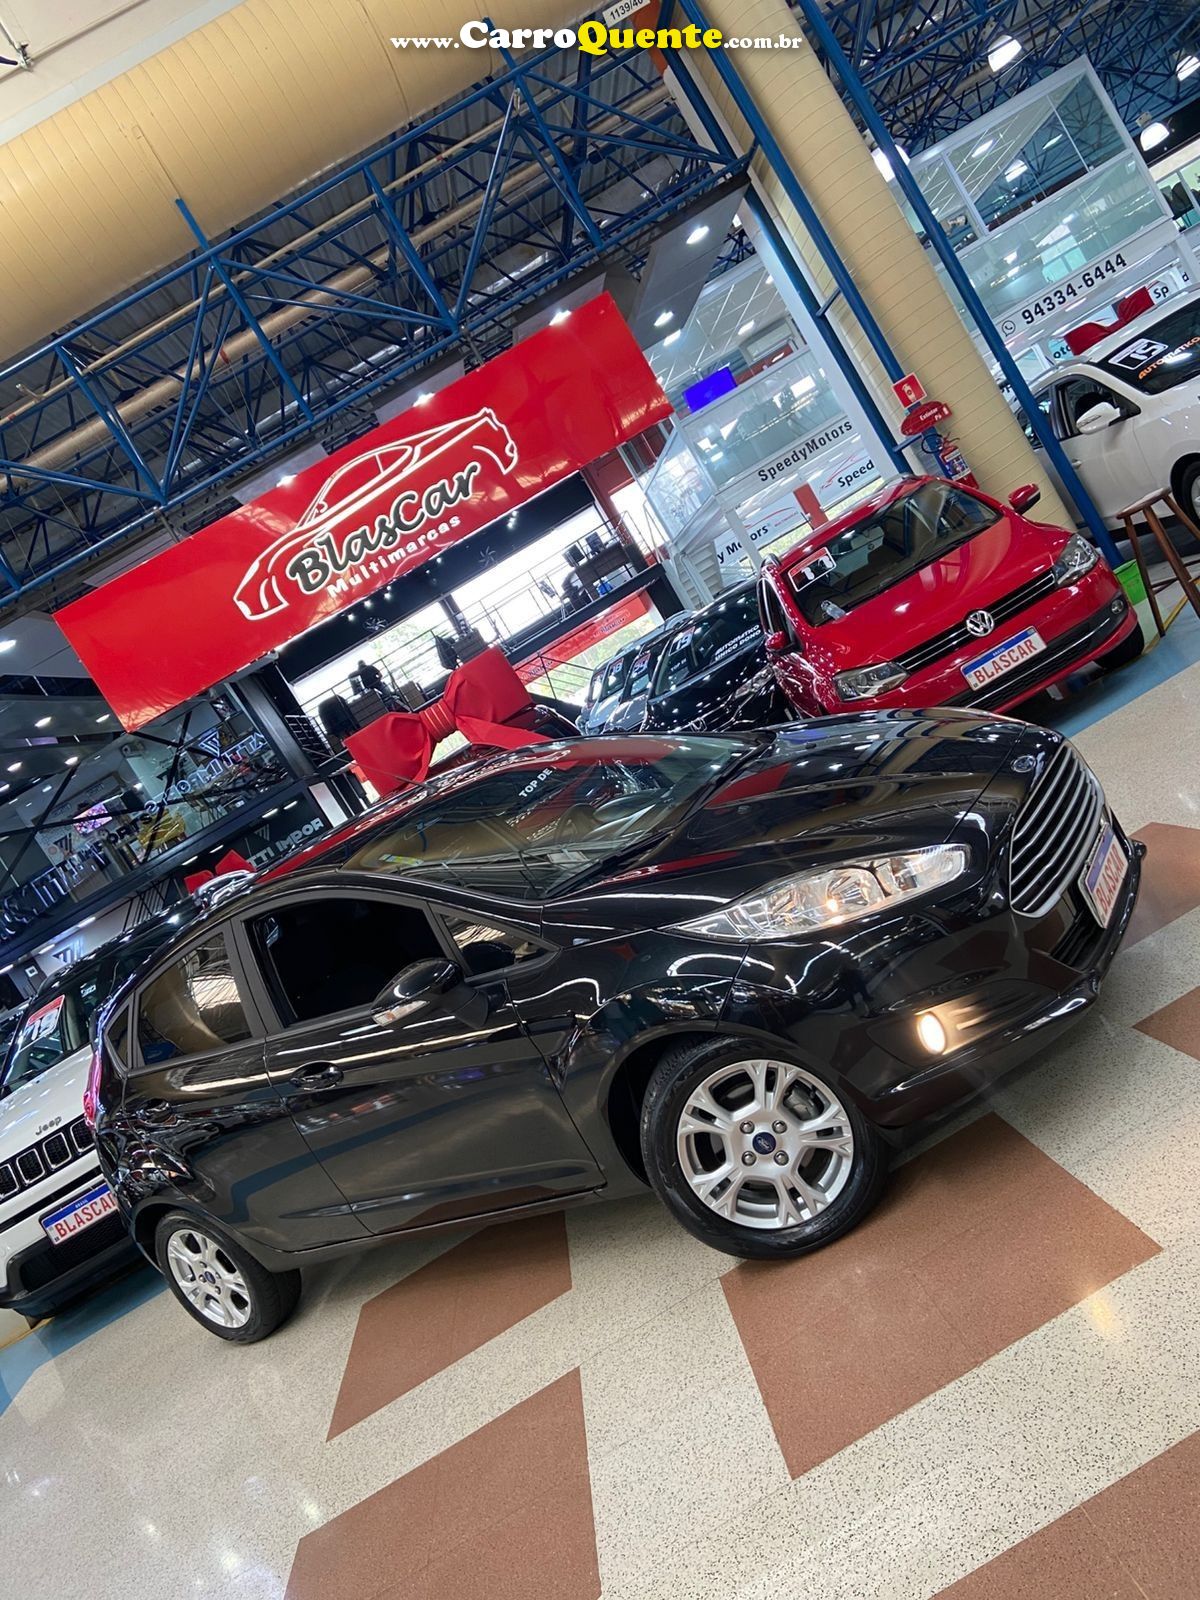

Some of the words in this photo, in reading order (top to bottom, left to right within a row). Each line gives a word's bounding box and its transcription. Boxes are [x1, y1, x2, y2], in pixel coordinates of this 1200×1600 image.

[1021, 253, 1128, 325] 94334-6444
[757, 420, 853, 482] SpeedyMotors
[836, 459, 875, 488] Speed
[286, 462, 481, 595] BlasCar
[327, 515, 461, 598] Multimarcas
[973, 638, 1037, 684] BLASCAR
[518, 780, 538, 797] TOP
[537, 768, 553, 781] DE
[1095, 844, 1125, 914] BLASCAR
[35, 1116, 62, 1136] Jeep
